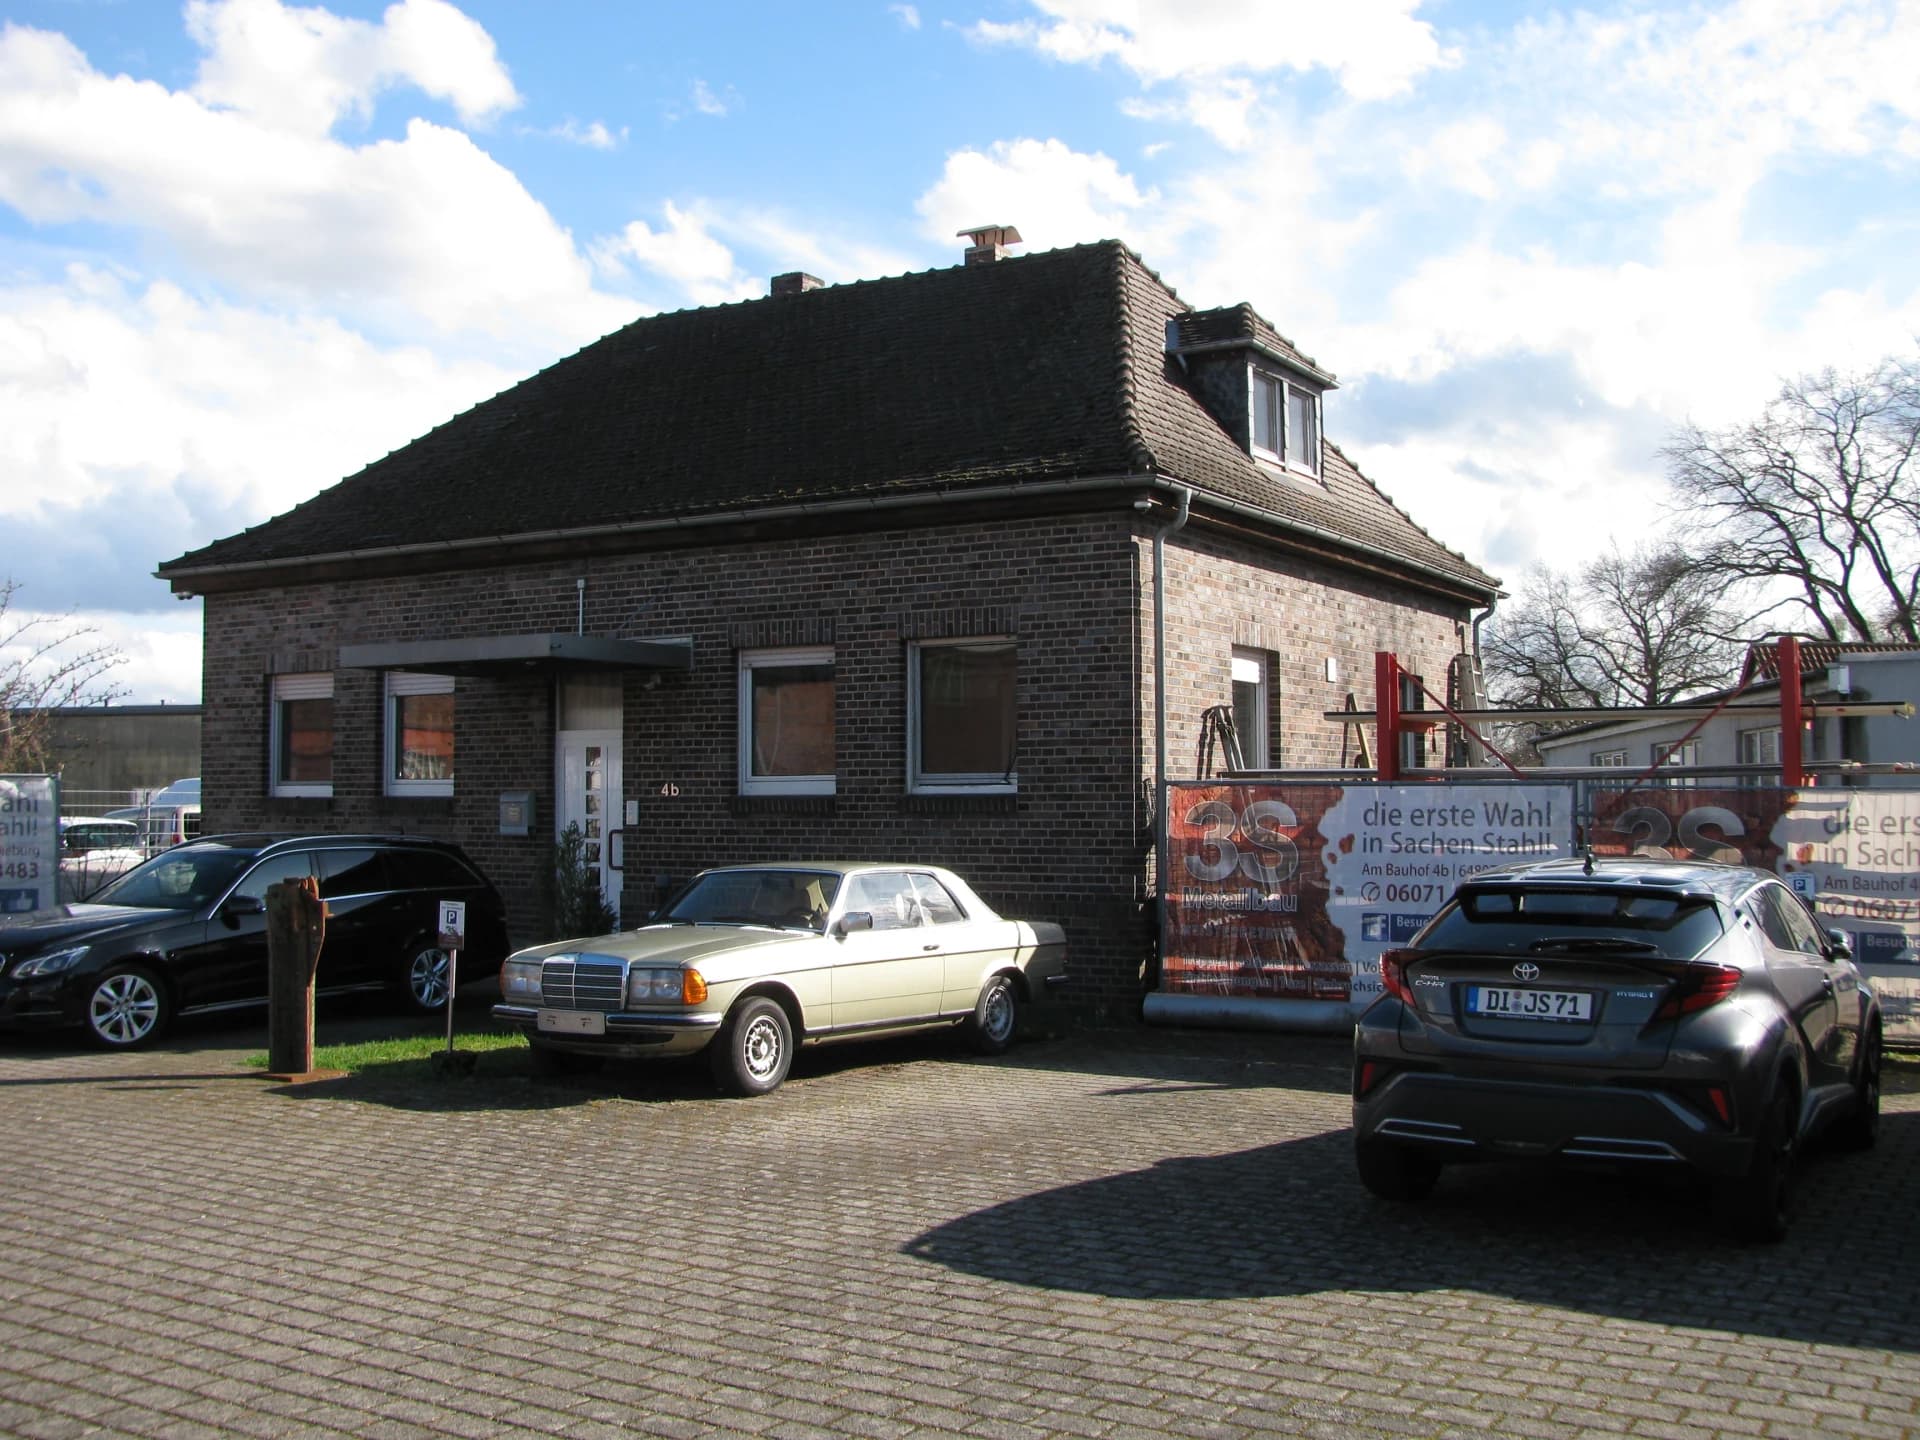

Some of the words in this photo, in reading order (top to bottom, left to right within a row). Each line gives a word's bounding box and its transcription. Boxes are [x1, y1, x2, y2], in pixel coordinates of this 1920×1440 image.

[661, 783, 680, 797] 4b
[1363, 801, 1402, 827] die
[1410, 804, 1475, 827] erste
[1484, 801, 1551, 827] Wahl
[1824, 808, 1870, 835] die
[1184, 800, 1298, 882] 3S
[1361, 832, 1383, 854] in
[1391, 832, 1474, 855] Sachen
[1482, 832, 1551, 855] Stahl!
[1823, 841, 1848, 865] in
[1857, 841, 1920, 866] Sach
[0, 862, 39, 879] 483
[1361, 863, 1383, 877] Am
[1386, 863, 1429, 877] Bauhof
[1432, 863, 1449, 877] 4b
[1458, 863, 1497, 877] 648
[1386, 884, 1444, 903] 06071
[1824, 875, 1848, 889] Am
[1853, 875, 1907, 891] Bauhof
[1181, 886, 1298, 912] Metallbau
[1486, 990, 1509, 1011] DI
